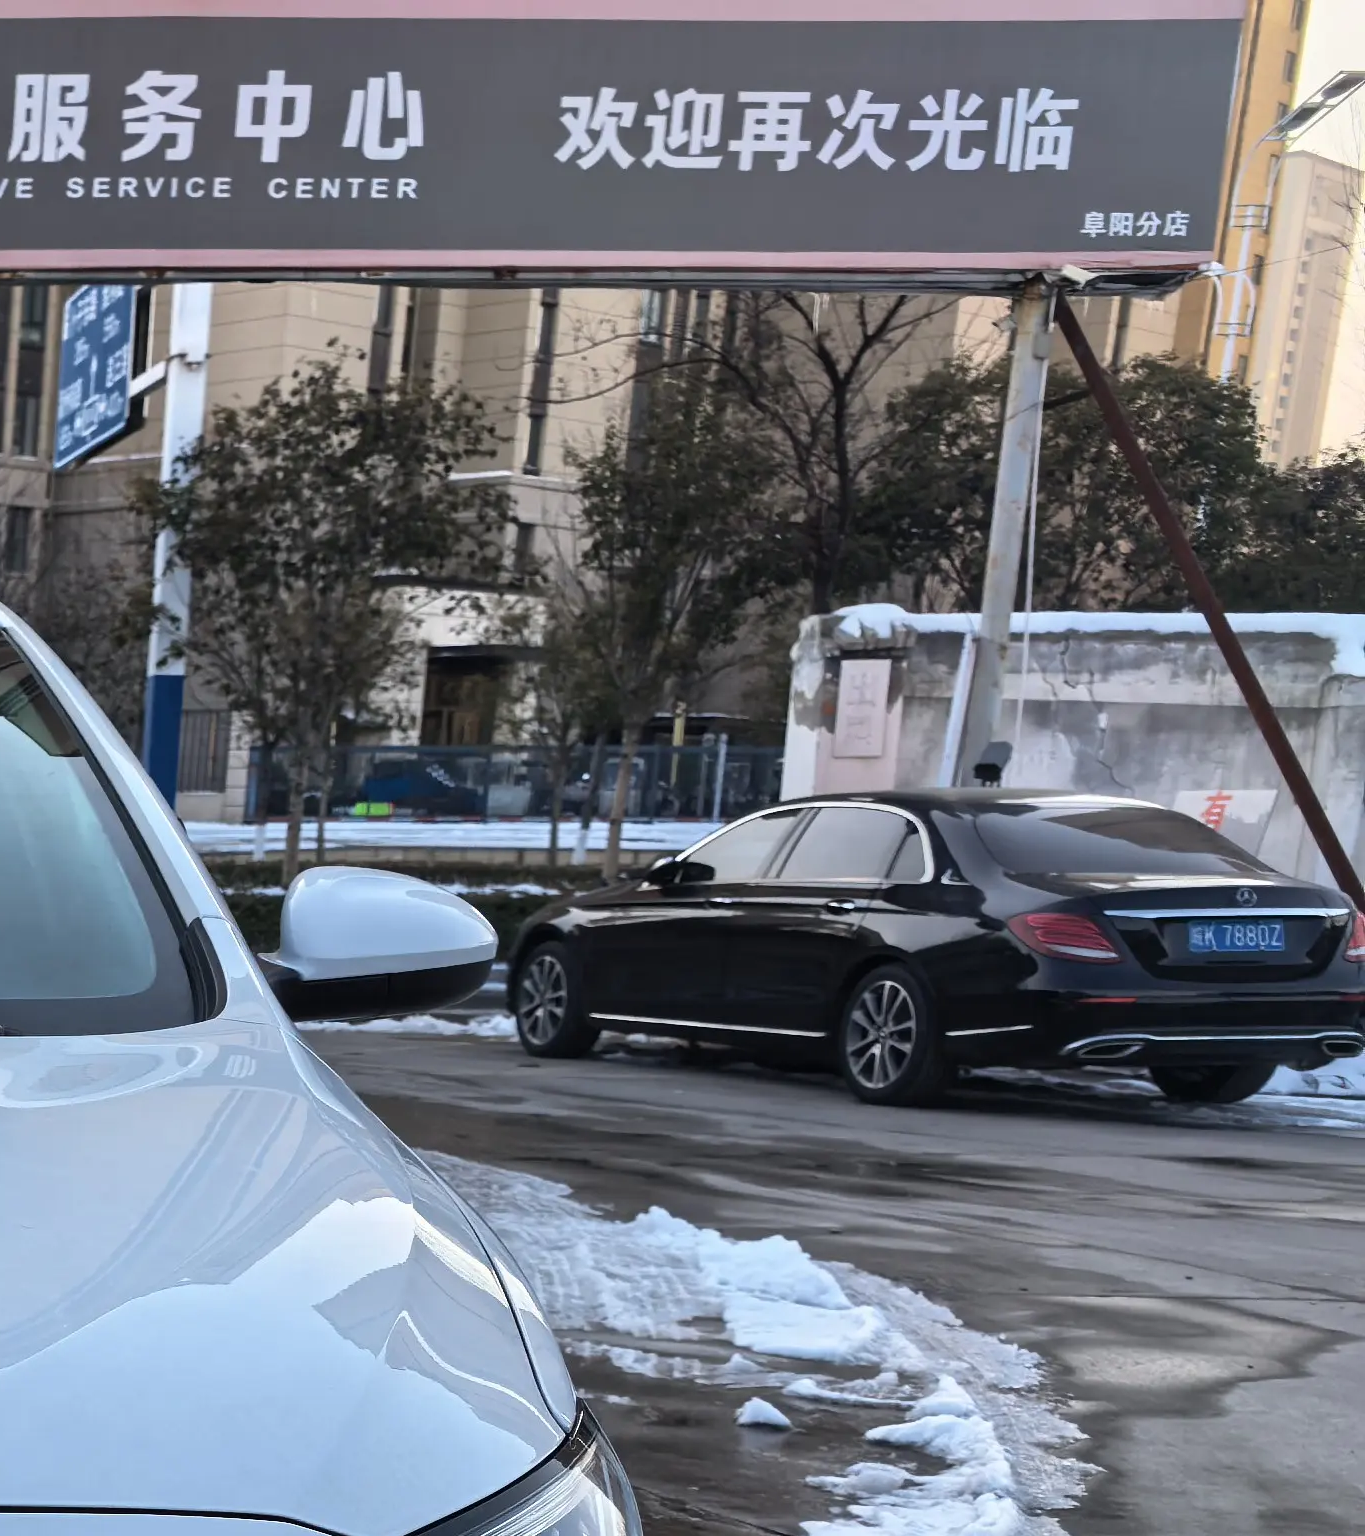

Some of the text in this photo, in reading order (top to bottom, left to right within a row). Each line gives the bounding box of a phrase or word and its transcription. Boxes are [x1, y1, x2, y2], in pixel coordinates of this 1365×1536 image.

[553, 87, 1080, 171] 欢迎再次光临
[66, 176, 232, 198] SERVICE
[268, 177, 418, 200] CENTER
[1080, 210, 1189, 237] 阜阳分店
